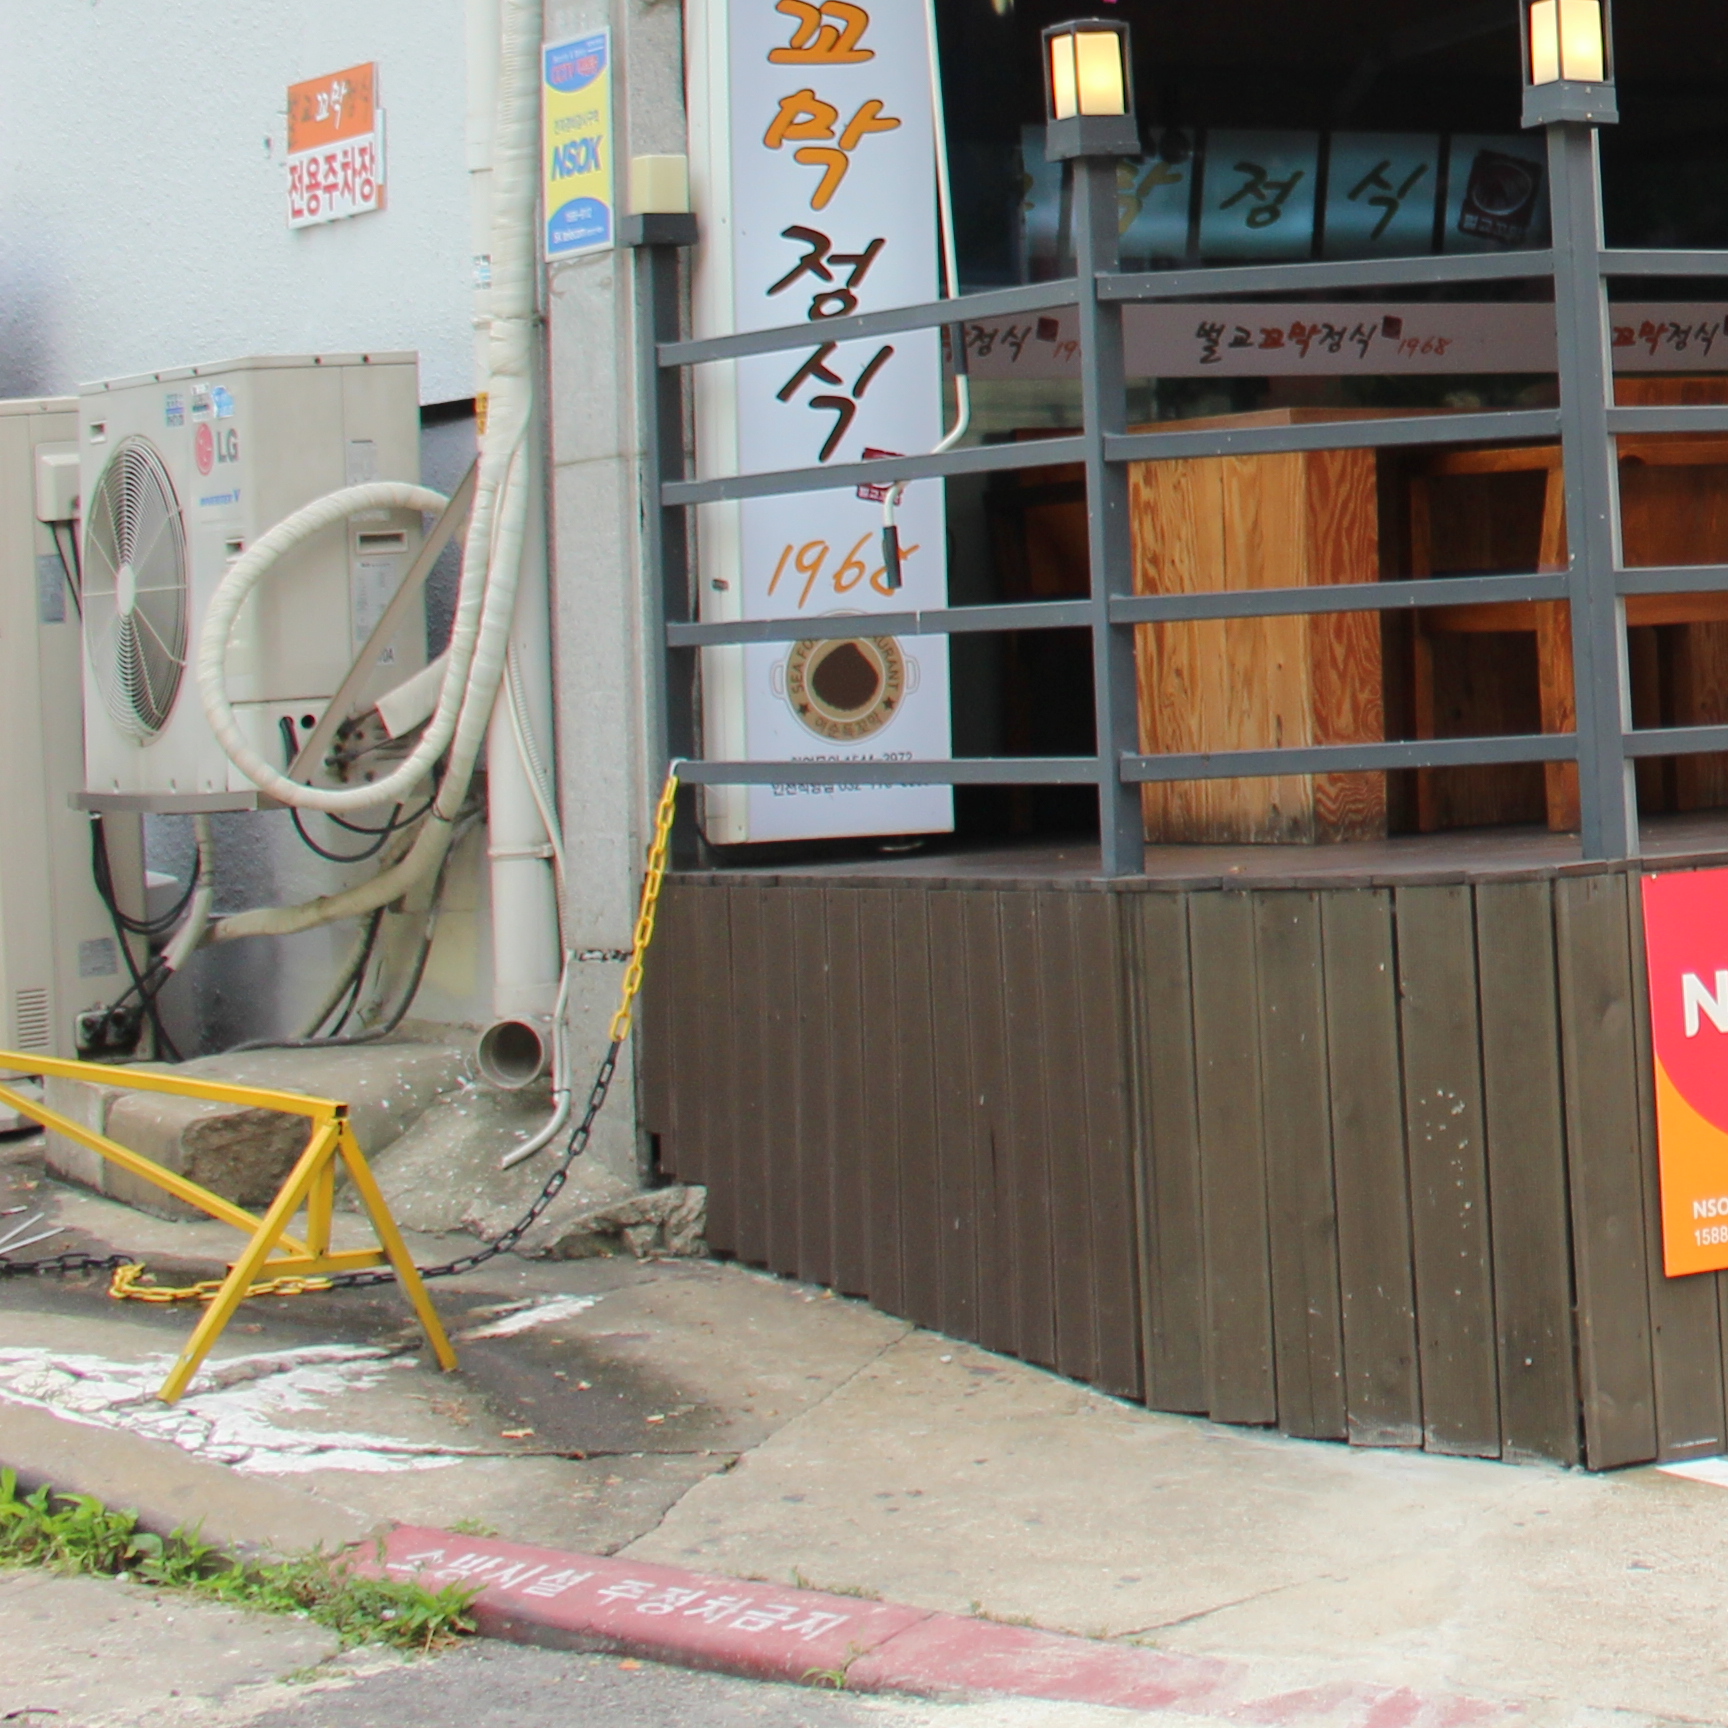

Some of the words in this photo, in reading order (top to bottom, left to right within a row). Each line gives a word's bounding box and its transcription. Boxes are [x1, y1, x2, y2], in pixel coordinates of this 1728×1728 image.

[288, 141, 376, 219] 전용주차장
[550, 135, 604, 181] NSOK
[1196, 319, 1378, 364] 벌교꼬막정식
[1398, 336, 1452, 357] 1968
[216, 428, 240, 463] LG
[386, 1548, 596, 1598] 소방시설
[597, 1577, 851, 1641] 주정차금지
